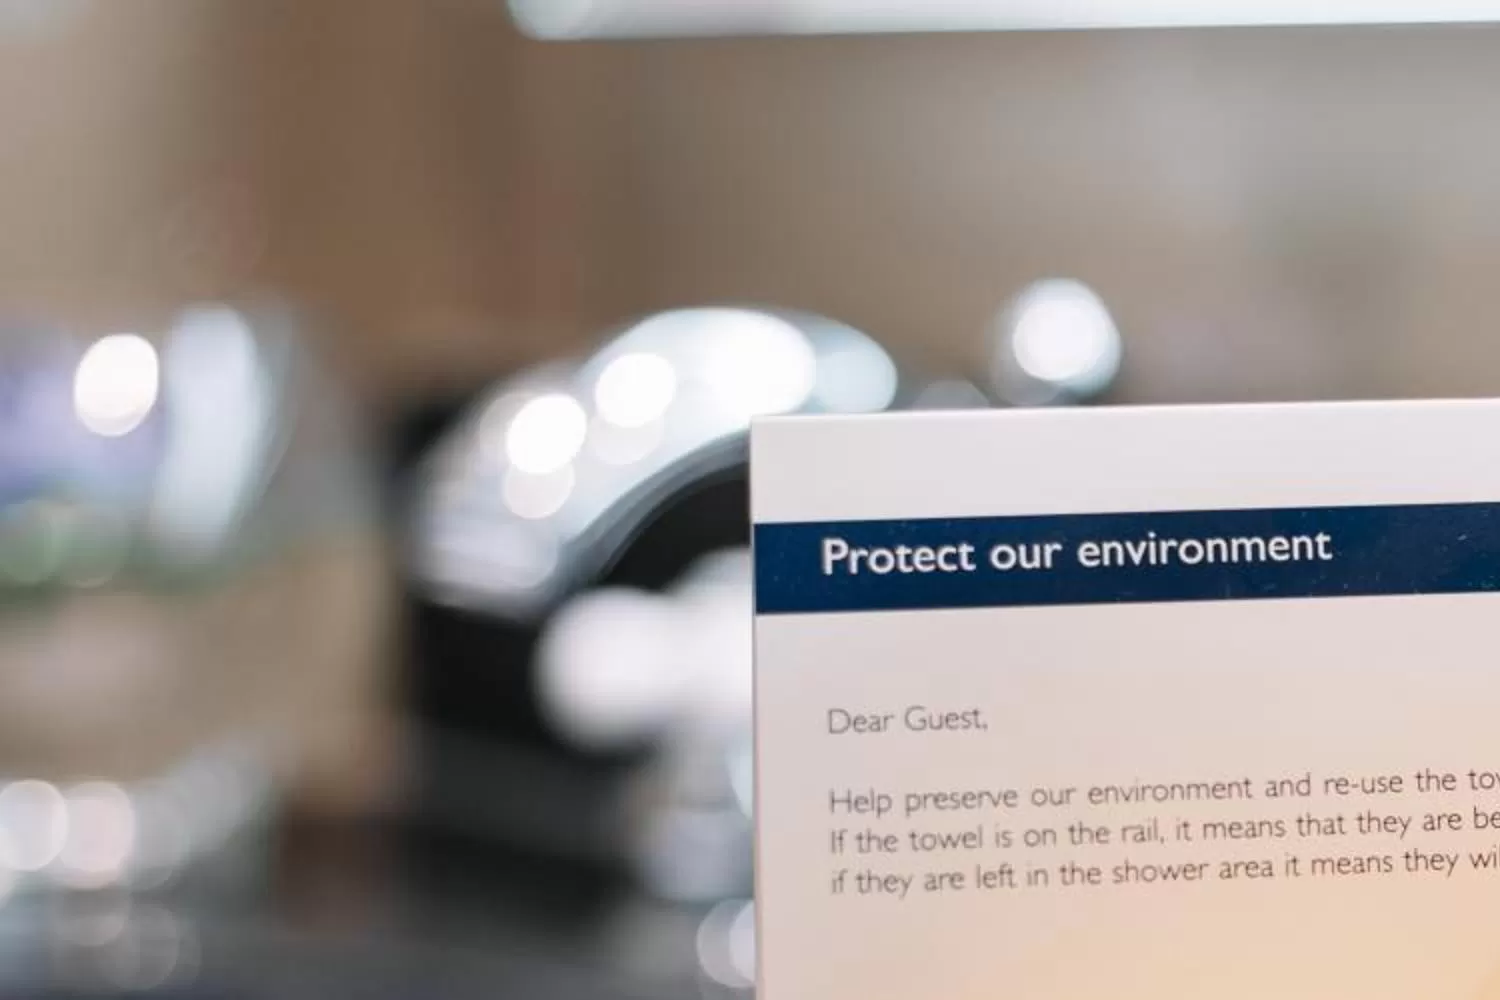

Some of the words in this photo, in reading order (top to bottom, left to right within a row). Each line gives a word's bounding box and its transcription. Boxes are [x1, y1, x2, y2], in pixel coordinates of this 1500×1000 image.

[821, 537, 976, 575] Protect
[989, 540, 1062, 570] our
[1076, 532, 1333, 568] environment
[827, 708, 894, 734] Dear
[903, 705, 988, 731] Guest,
[828, 789, 893, 819] Help
[905, 788, 1018, 817] preserve
[1030, 785, 1076, 807] our
[1087, 777, 1252, 806] environment
[1264, 772, 1311, 798] and
[1323, 773, 1404, 796] re-use
[1415, 768, 1456, 793] the
[830, 828, 846, 854] If
[856, 827, 899, 854] the
[909, 825, 983, 852] towel
[995, 823, 1013, 849] is
[1023, 826, 1057, 848] on
[1068, 820, 1110, 845] the
[1121, 818, 1165, 846] rail,
[1175, 817, 1192, 842] it
[1202, 818, 1287, 842] means
[1296, 812, 1346, 837] that
[1357, 811, 1412, 840] they
[1423, 812, 1462, 832] are
[830, 869, 846, 895] if
[856, 869, 913, 899] they
[923, 869, 965, 892] are
[976, 864, 1016, 890] left
[1027, 864, 1049, 887] in
[1060, 861, 1101, 886] the
[1112, 858, 1209, 884] shower
[1219, 858, 1274, 880] area
[1285, 852, 1301, 877] it
[1311, 855, 1393, 877] means
[1404, 849, 1459, 878] they
